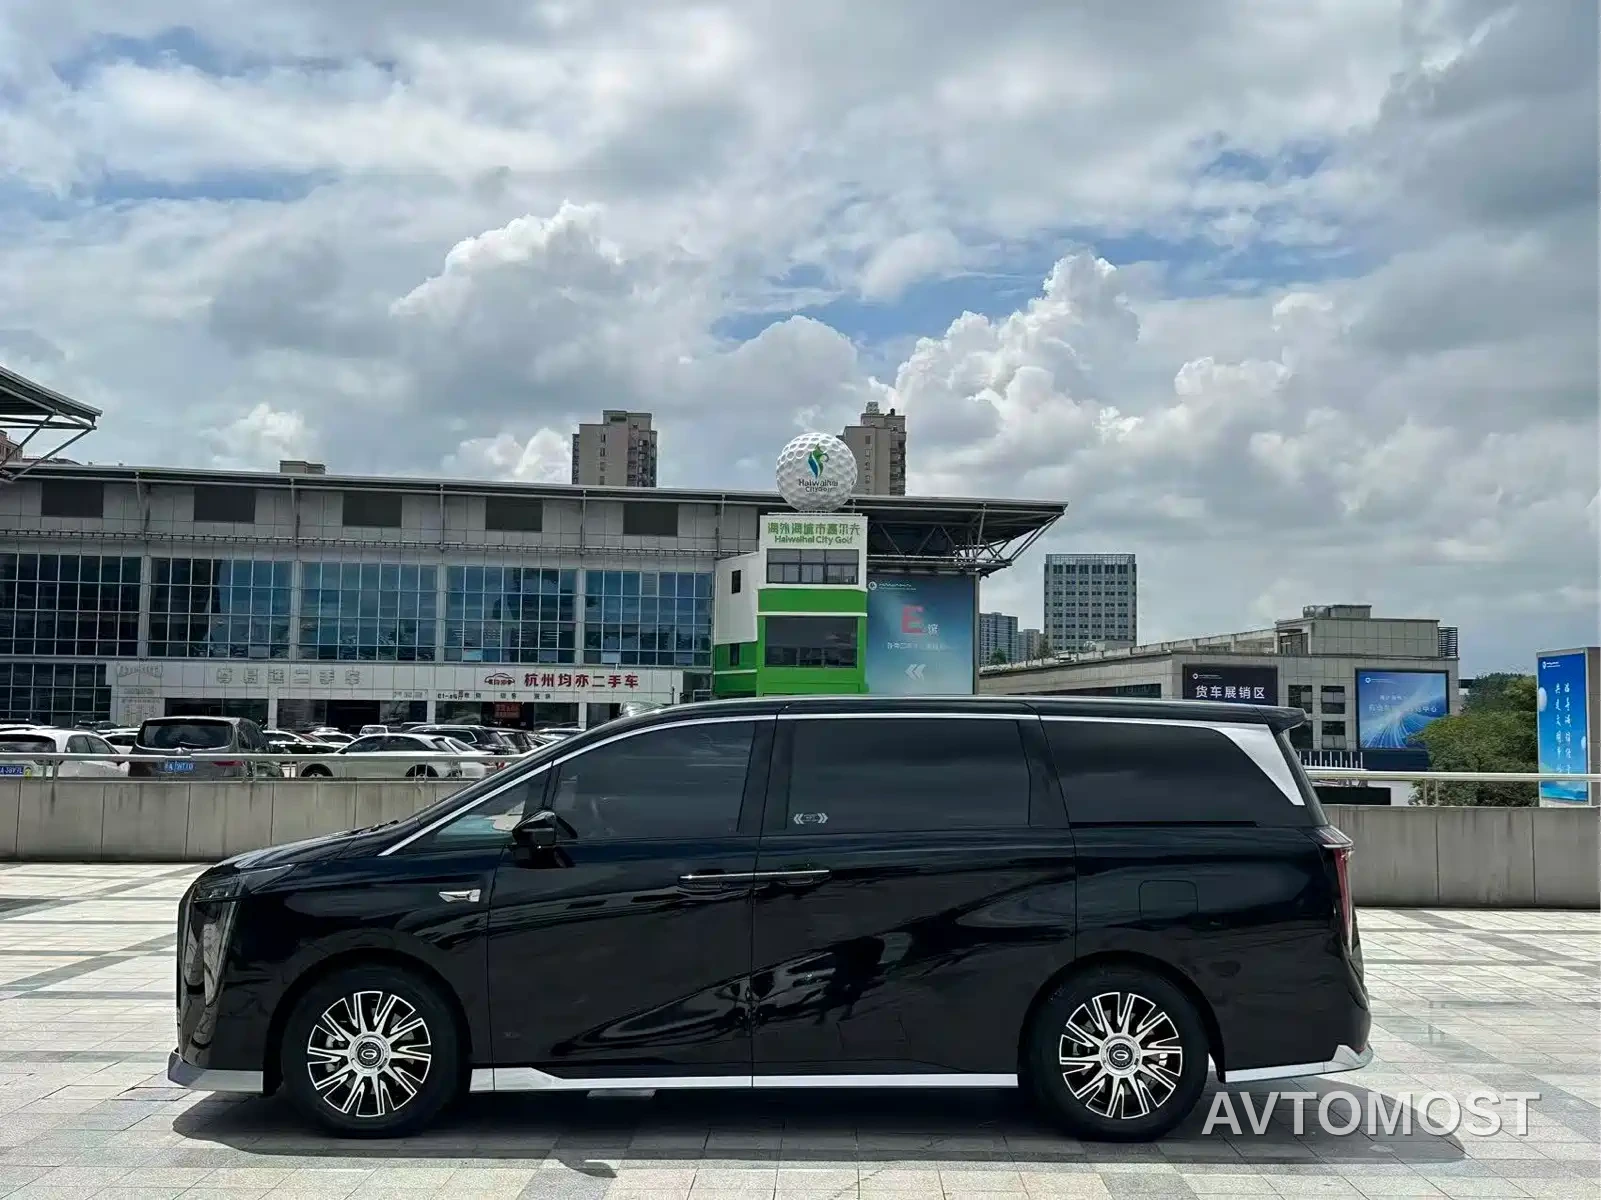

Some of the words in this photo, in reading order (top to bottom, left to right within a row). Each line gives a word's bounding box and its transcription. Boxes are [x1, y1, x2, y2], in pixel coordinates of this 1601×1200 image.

[816, 535, 834, 546] City
[524, 672, 639, 688] 杭州均亦二手车
[1195, 685, 1265, 699] 货车展销区
